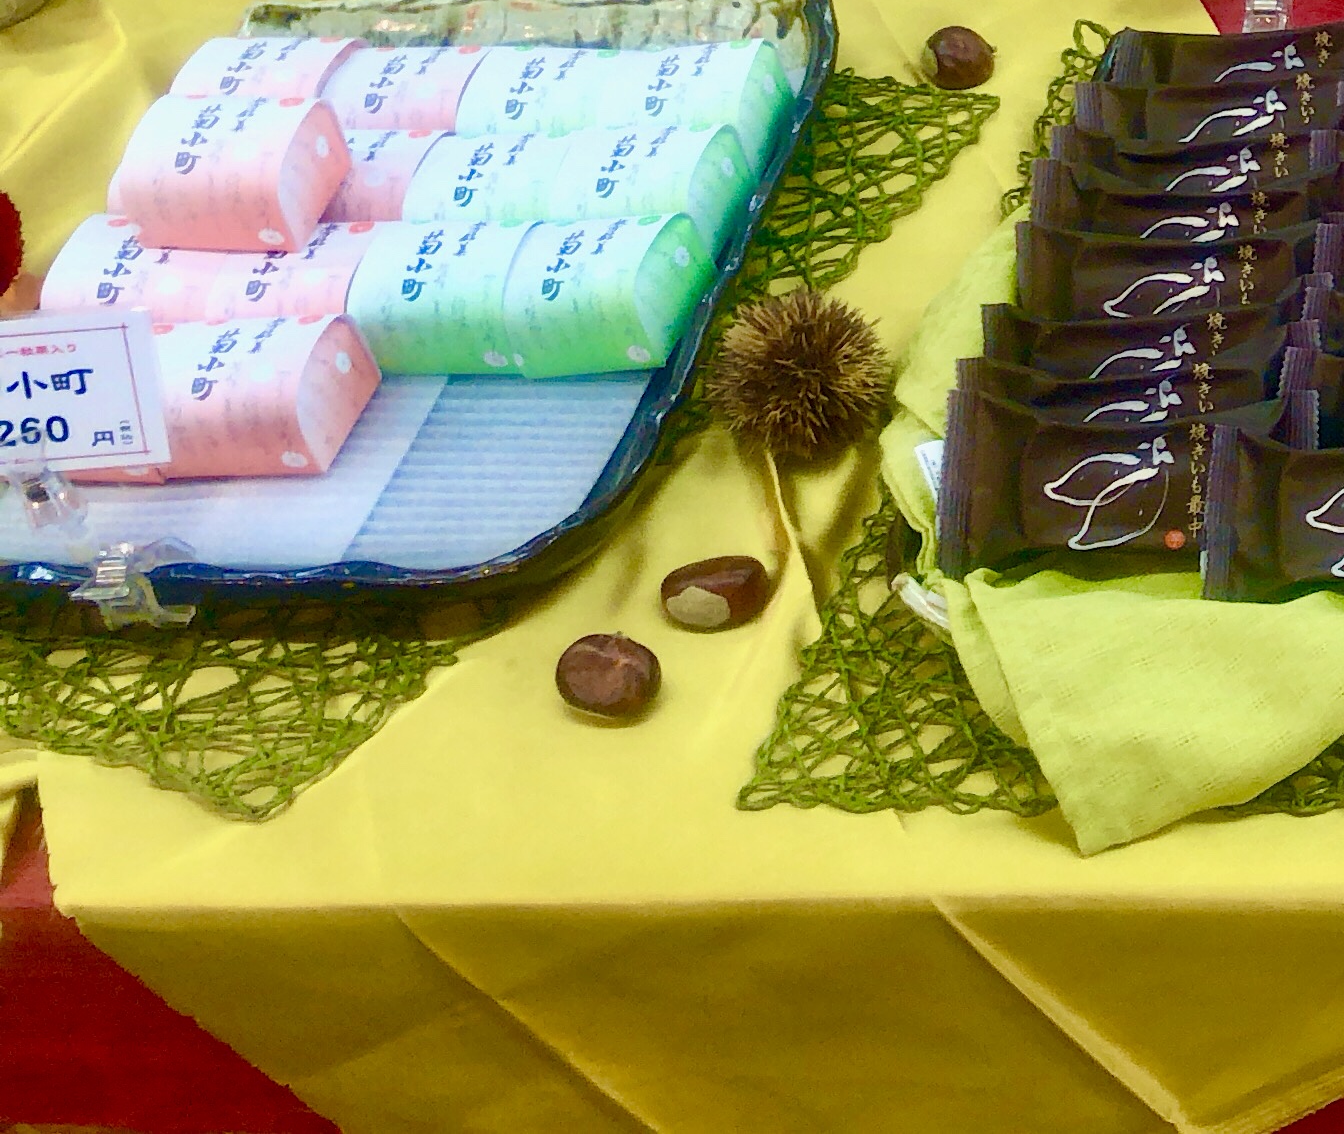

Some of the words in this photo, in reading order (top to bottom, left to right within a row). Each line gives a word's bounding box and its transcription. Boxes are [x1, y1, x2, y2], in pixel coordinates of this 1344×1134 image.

[219, 41, 268, 96] 菊小町
[363, 54, 408, 114] 菊小町
[505, 57, 547, 121] 菊小町
[644, 54, 681, 117] 菊小町
[174, 103, 222, 175] 菊小町
[595, 133, 637, 199] 菊小町
[453, 142, 495, 208] 菊小町
[401, 229, 445, 303] 菊小町
[541, 229, 585, 301] 菊小町
[190, 327, 241, 402] 菊小町
[1186, 423, 1211, 539] 焼きいも最中
